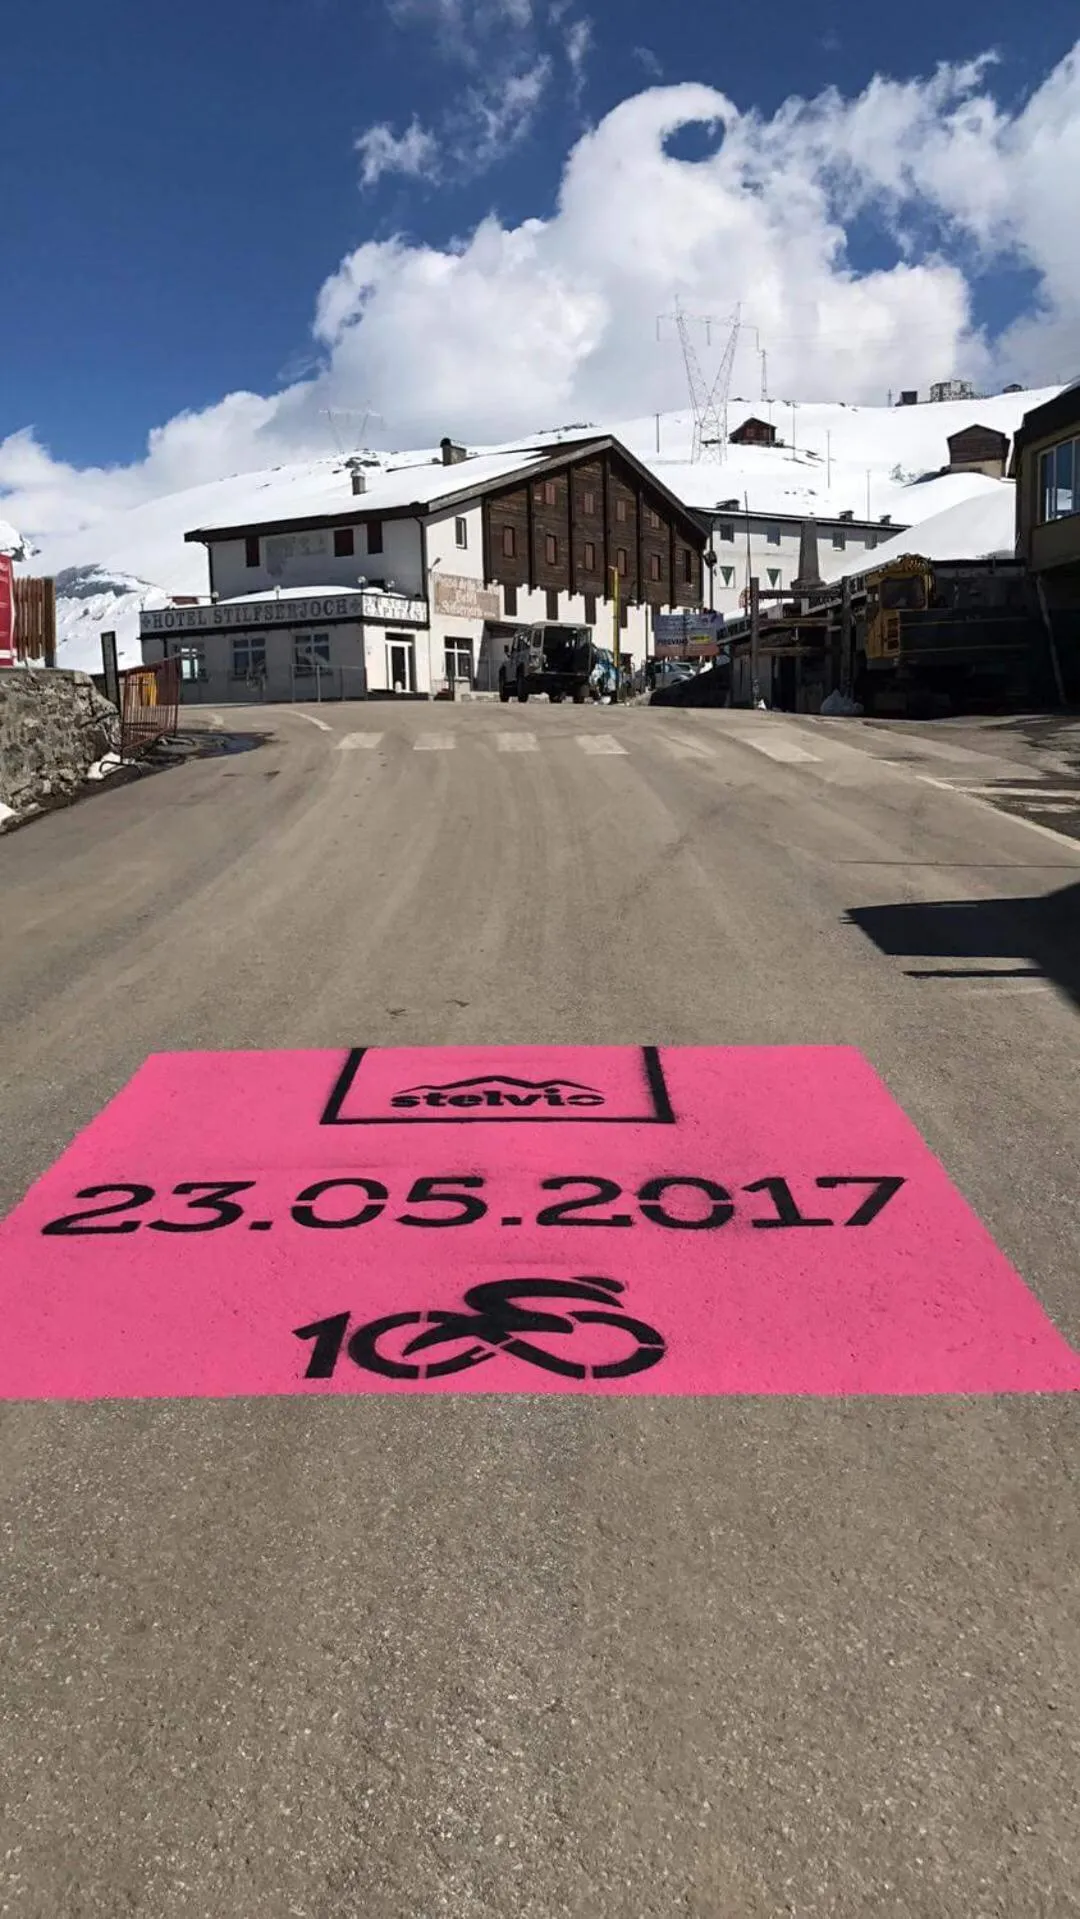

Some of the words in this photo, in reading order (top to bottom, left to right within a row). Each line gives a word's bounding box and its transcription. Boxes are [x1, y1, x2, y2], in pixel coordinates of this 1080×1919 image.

[152, 610, 207, 628] HOTEL
[213, 599, 348, 624] STILFSERJOCH
[390, 1088, 605, 1107] stelvio
[41, 1176, 906, 1235] 23.05.2017
